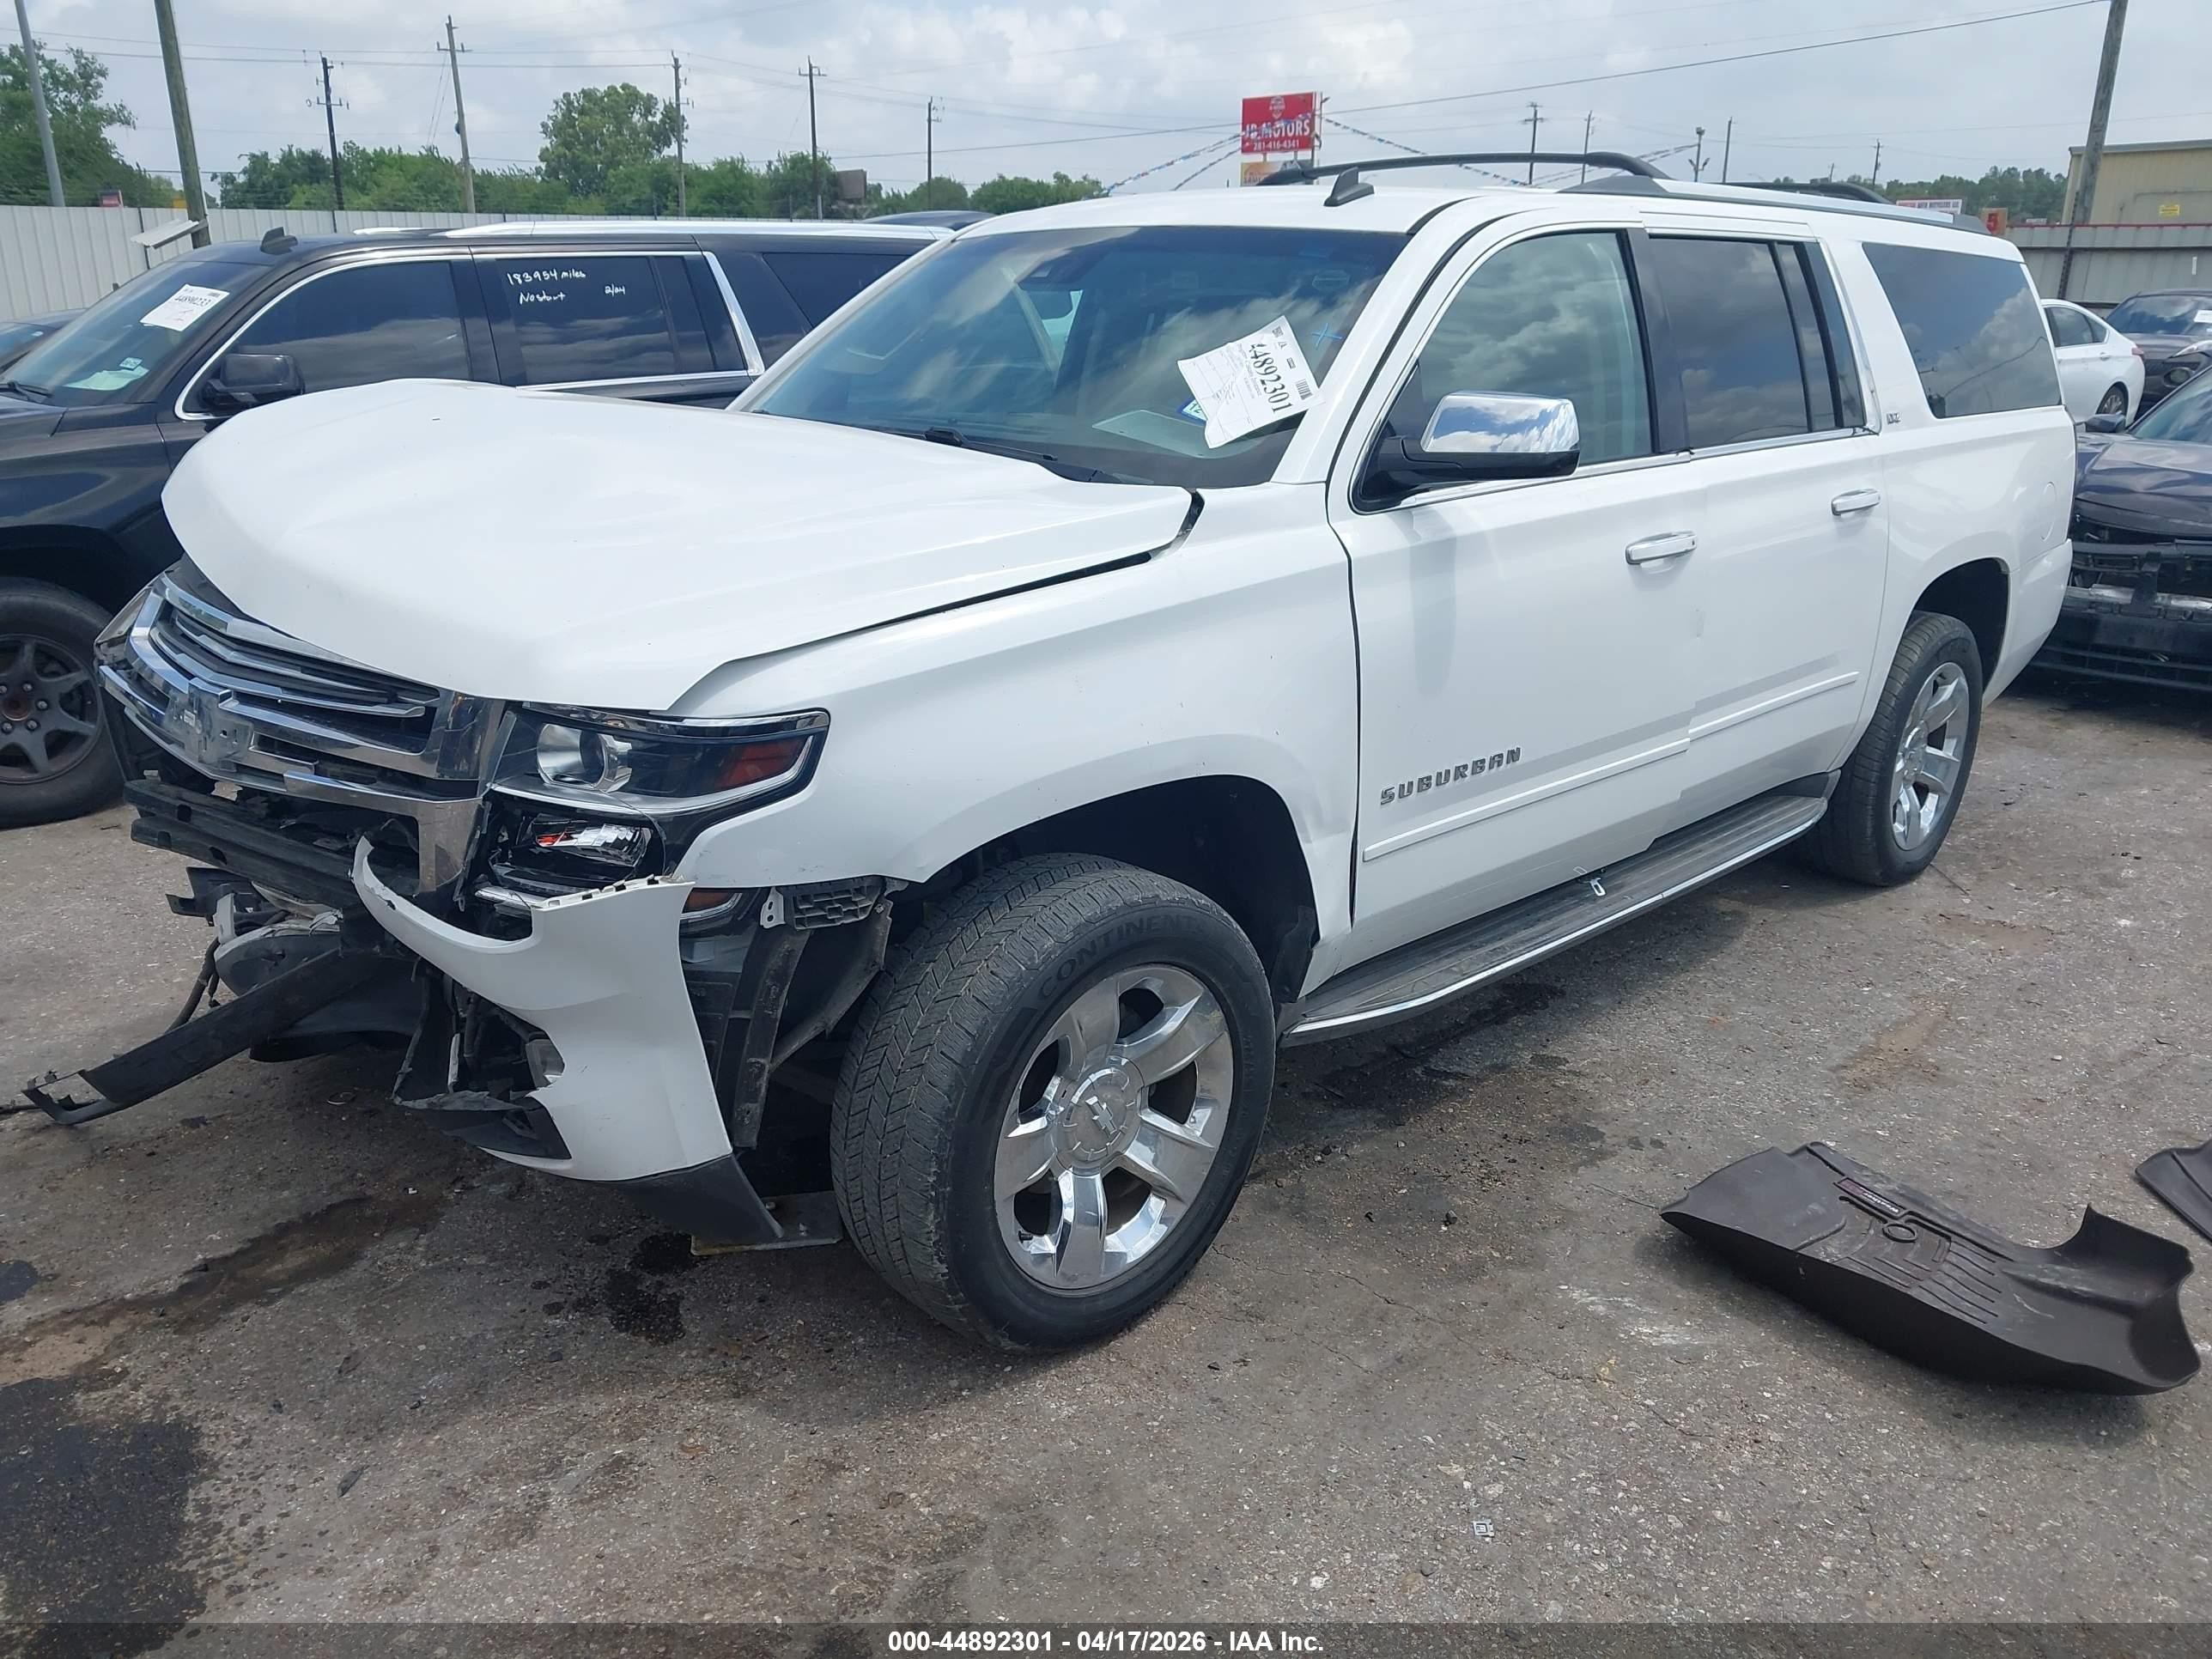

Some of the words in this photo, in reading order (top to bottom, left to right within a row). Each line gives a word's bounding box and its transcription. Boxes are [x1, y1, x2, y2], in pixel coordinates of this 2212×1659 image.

[507, 268, 558, 285] 183954
[561, 268, 586, 279] miles
[1249, 342, 1294, 413] 44892301
[1380, 747, 1521, 805] SUBURBAN
